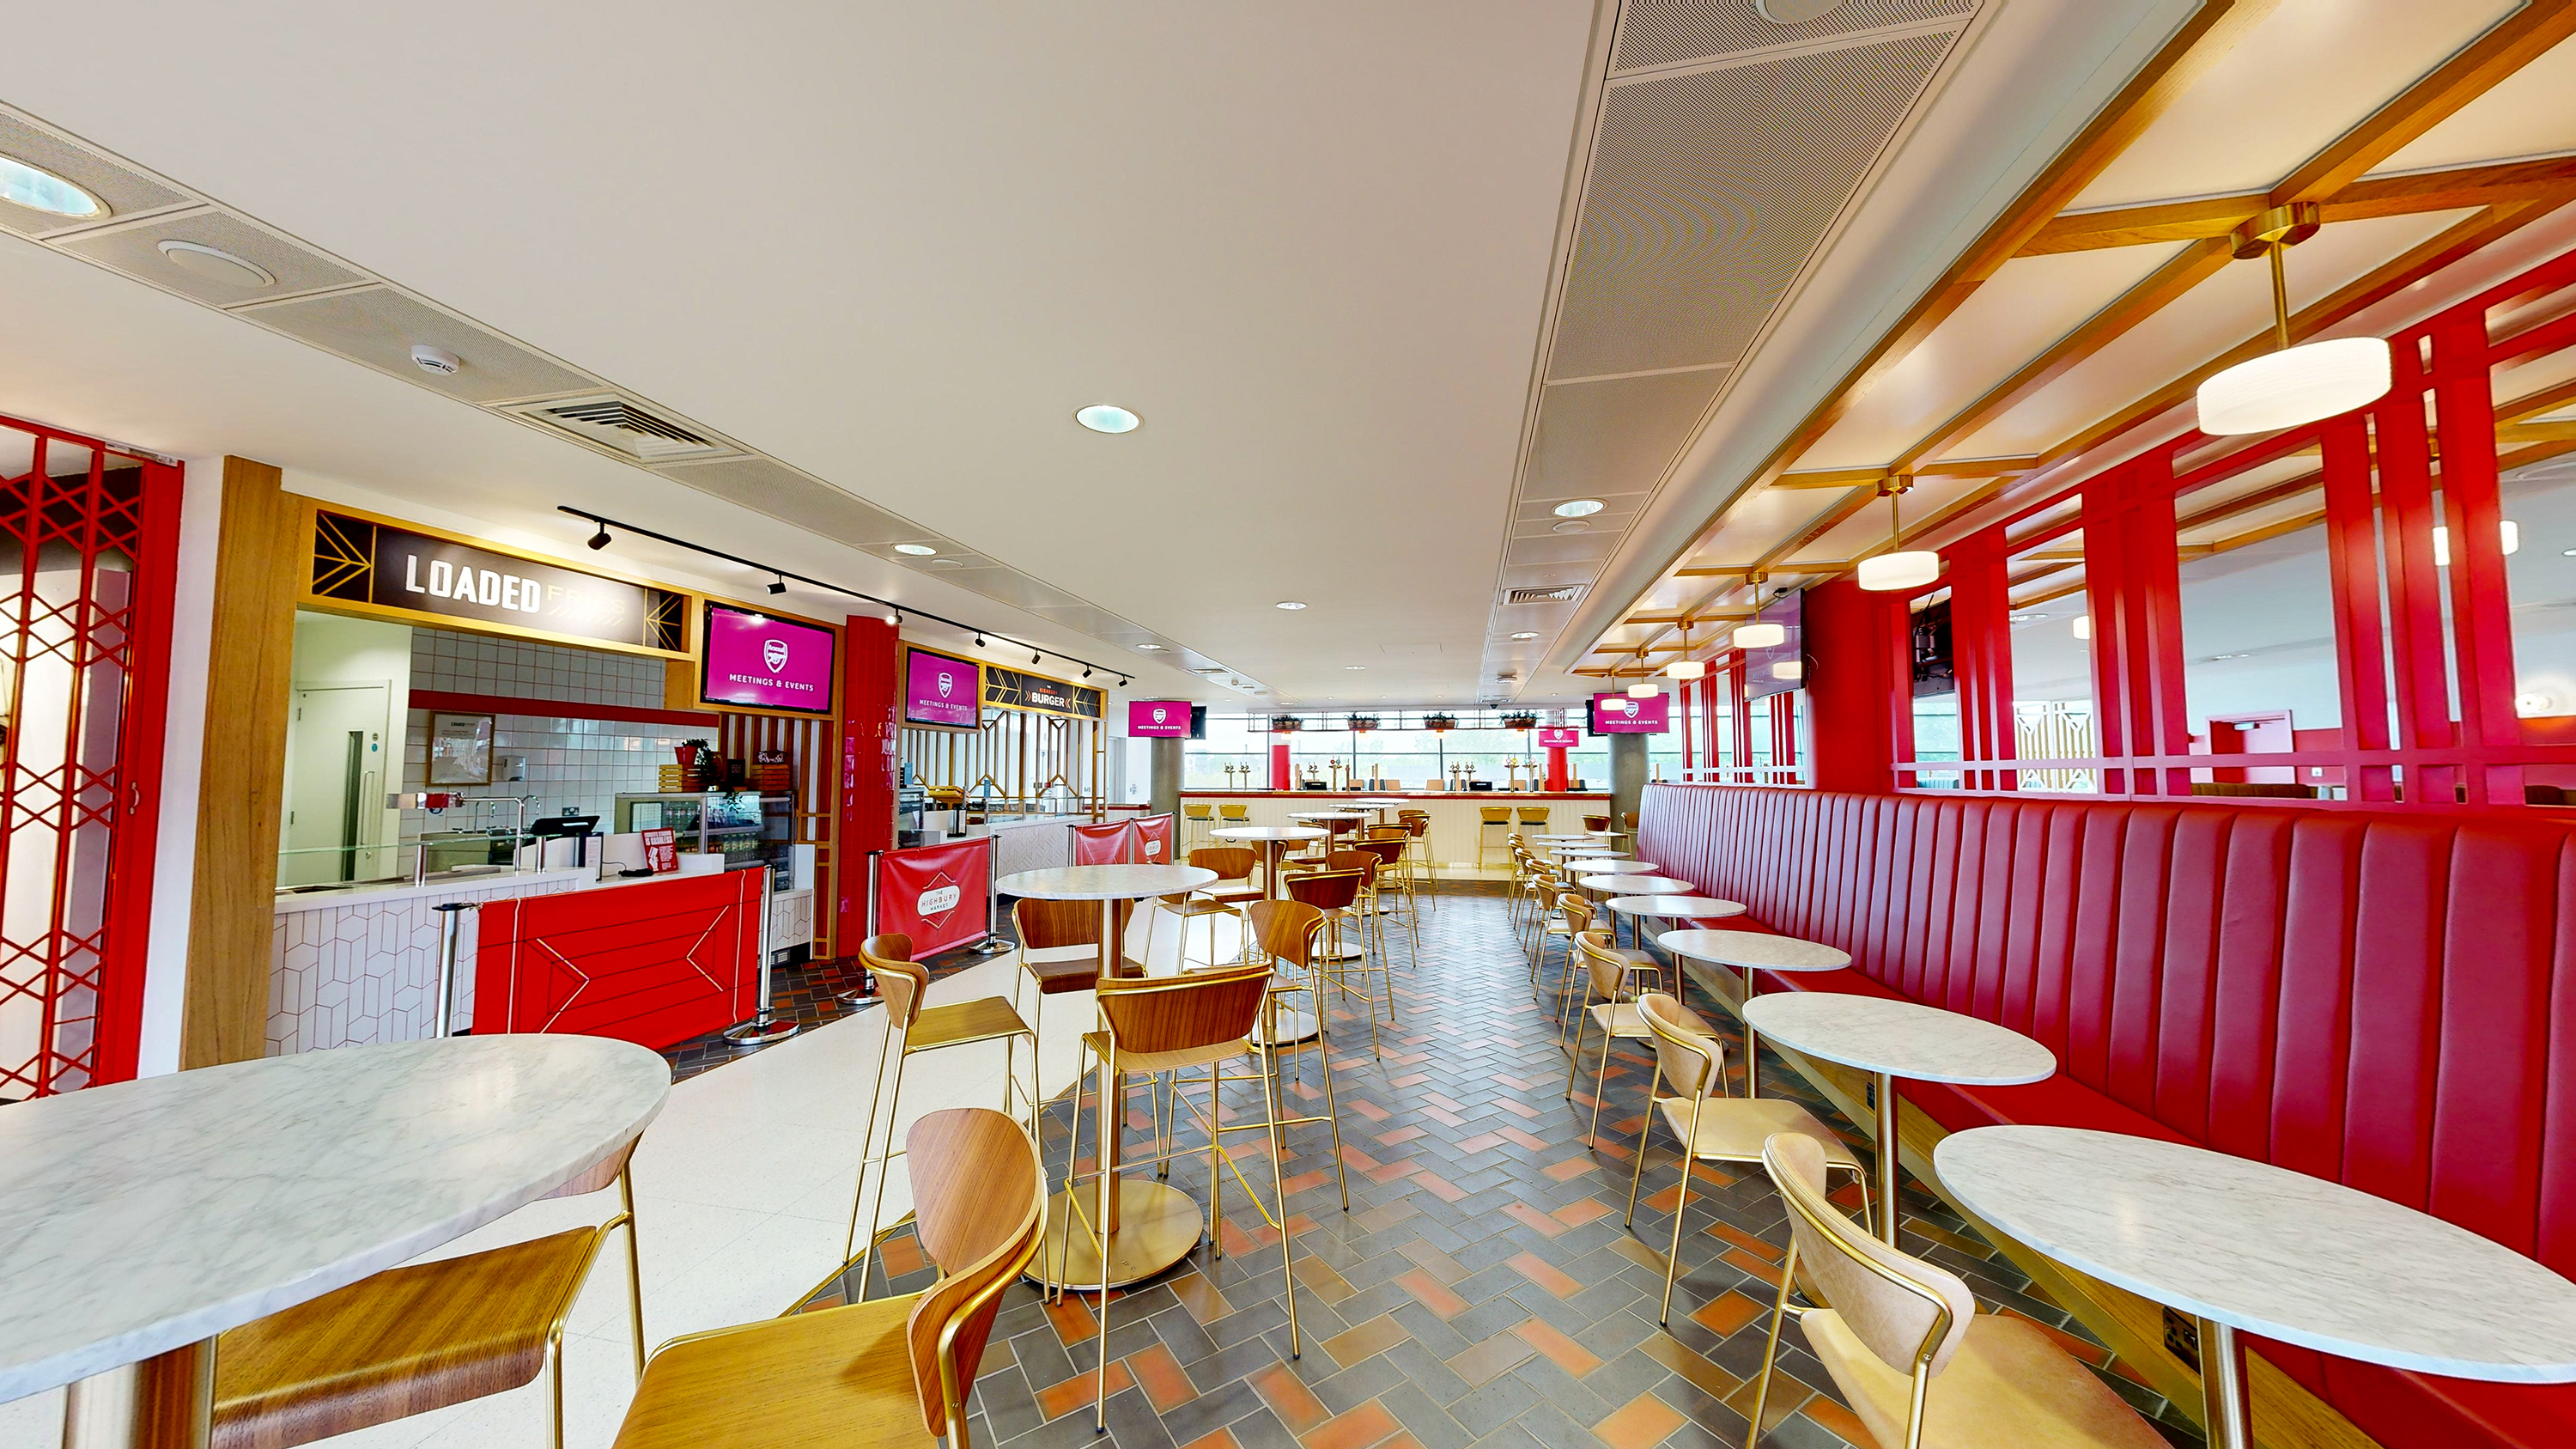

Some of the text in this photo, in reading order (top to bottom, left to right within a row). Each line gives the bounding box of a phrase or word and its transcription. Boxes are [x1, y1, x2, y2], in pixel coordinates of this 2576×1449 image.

[405, 554, 541, 614] LOADED
[729, 673, 815, 692] MEETINGS & EVENTS
[919, 699, 945, 709] MEETINGS
[1031, 691, 1065, 708] BURGER
[921, 892, 957, 908] HIGHBURY
